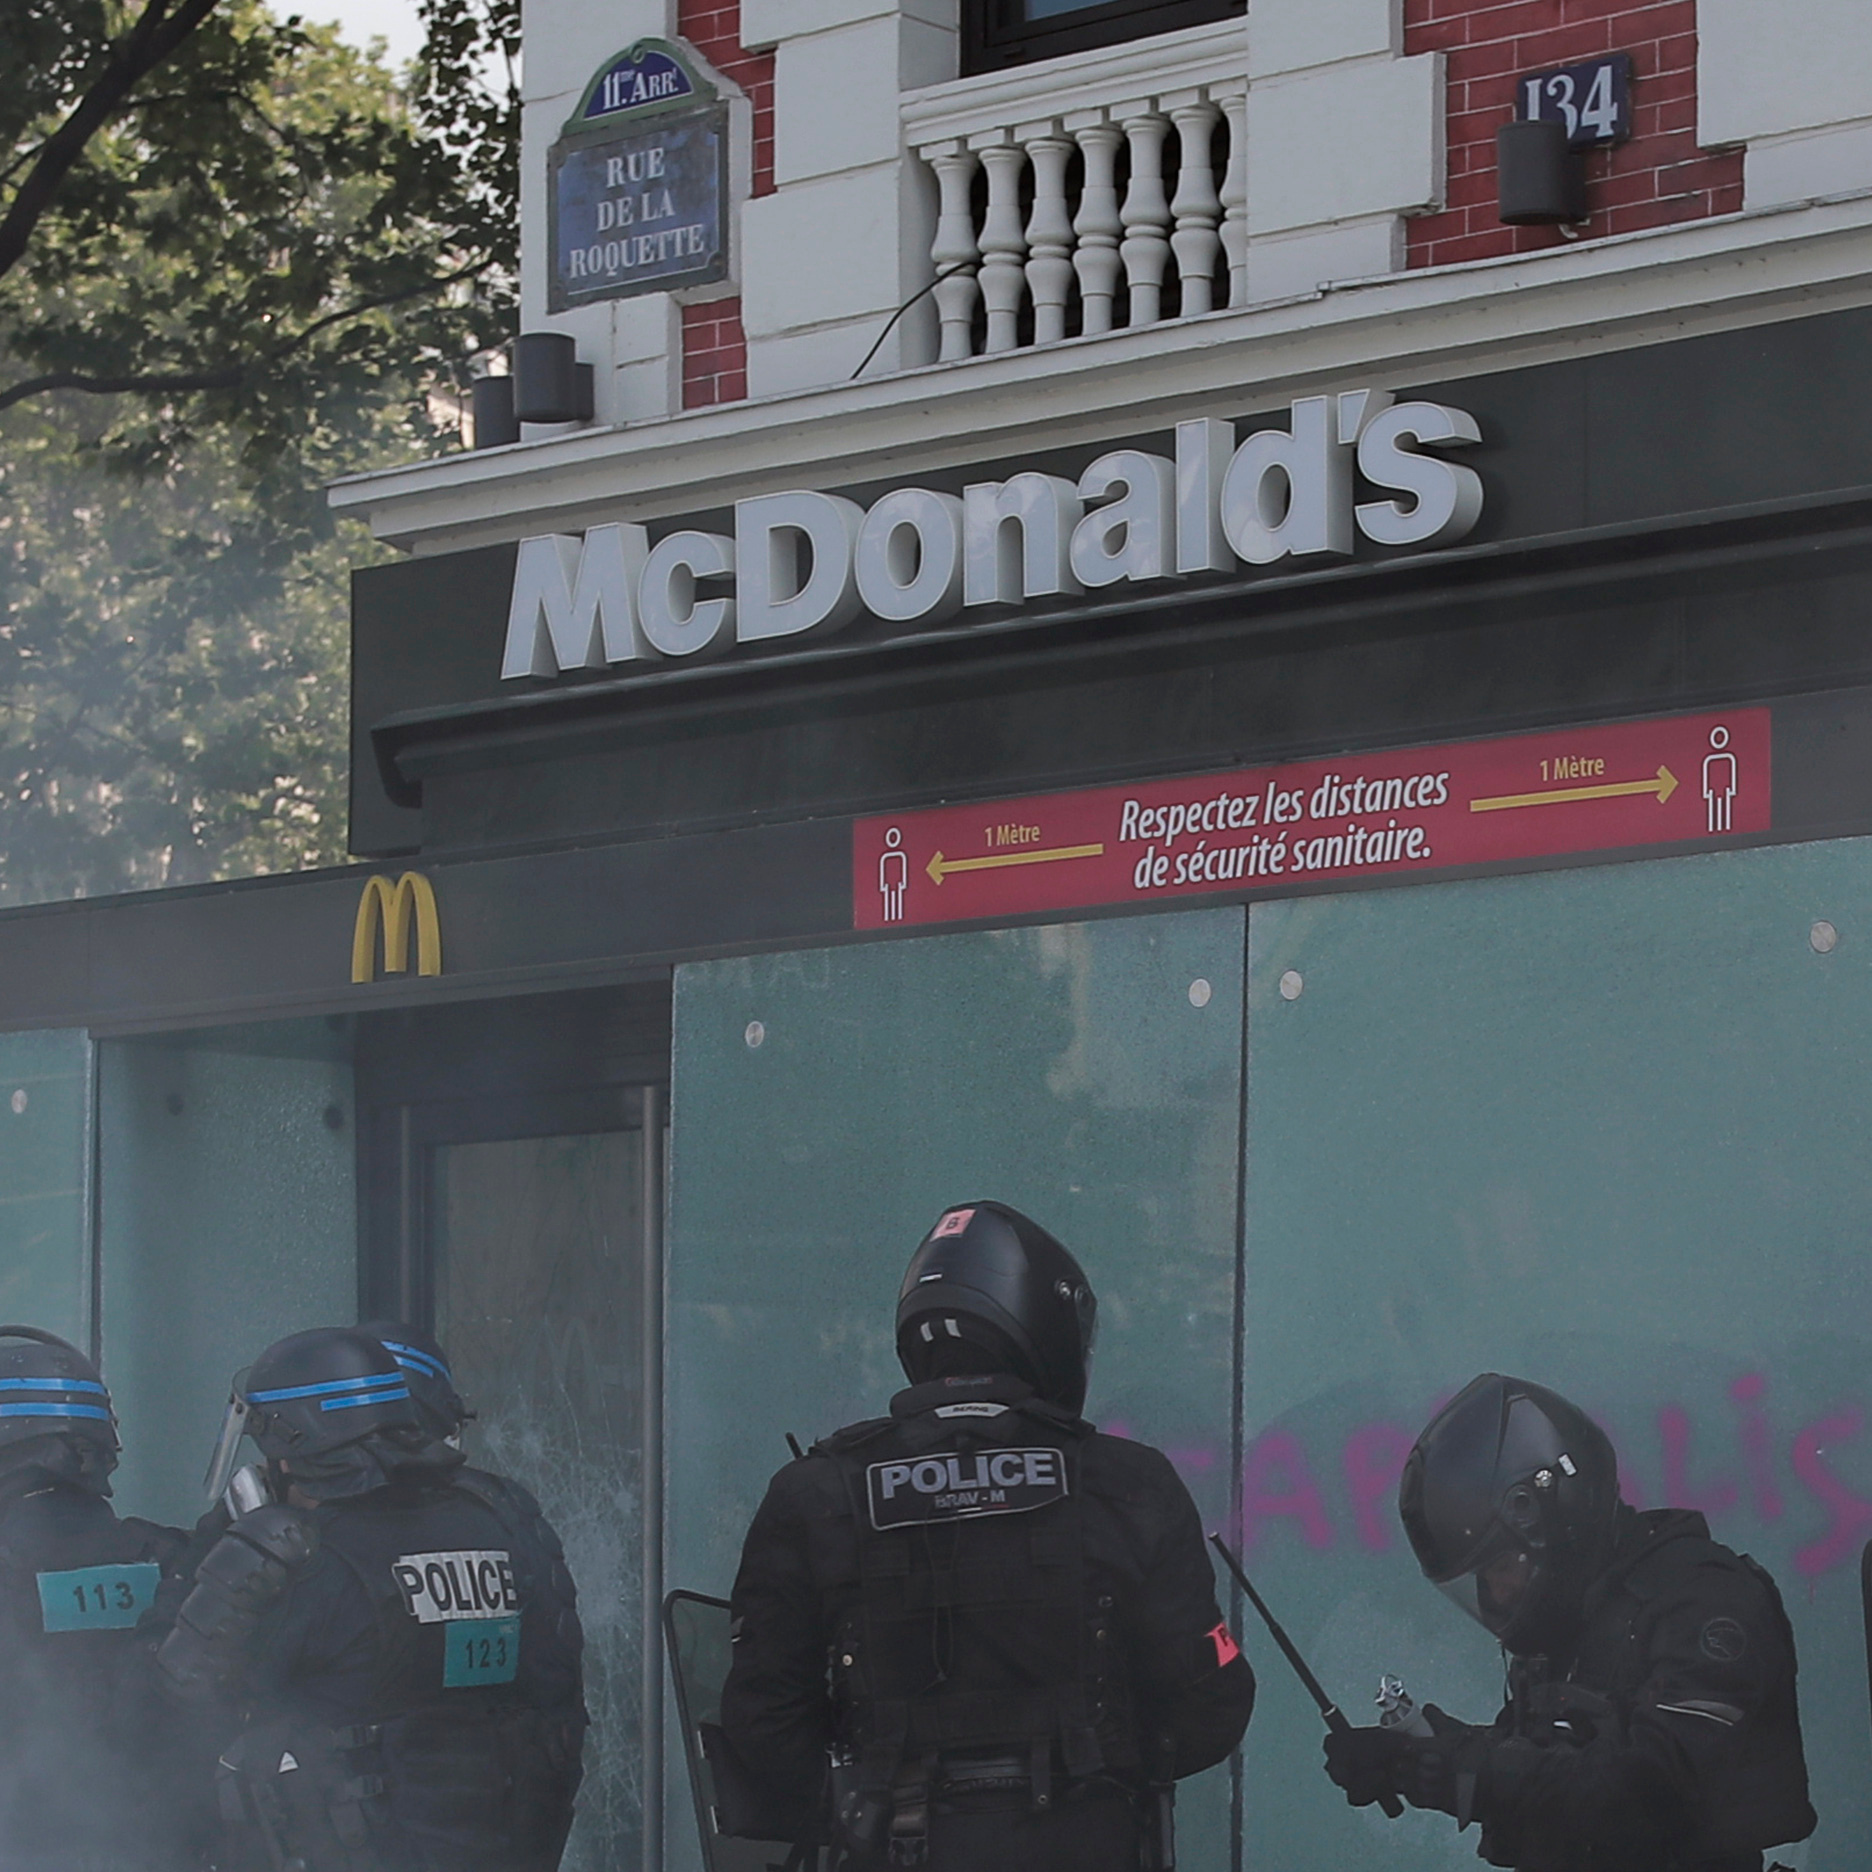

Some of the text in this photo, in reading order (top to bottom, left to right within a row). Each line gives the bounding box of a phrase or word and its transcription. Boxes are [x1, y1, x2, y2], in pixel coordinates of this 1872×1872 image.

[1524, 64, 1618, 140] 134
[606, 147, 665, 188] RUE
[597, 189, 675, 232] DE LA
[569, 224, 704, 279] ROQUETTE
[501, 387, 1483, 680] McDonald's
[1539, 756, 1605, 782] 1 Mètre
[1118, 771, 1449, 846] Respectez les distances
[984, 824, 1041, 848] 1 Mètre
[1133, 819, 1432, 889] de sécurité sanitaire.
[880, 1452, 1057, 1500] POLICE
[72, 1581, 135, 1613] 113
[392, 1559, 518, 1614] POLICE
[464, 1637, 507, 1669] 123
